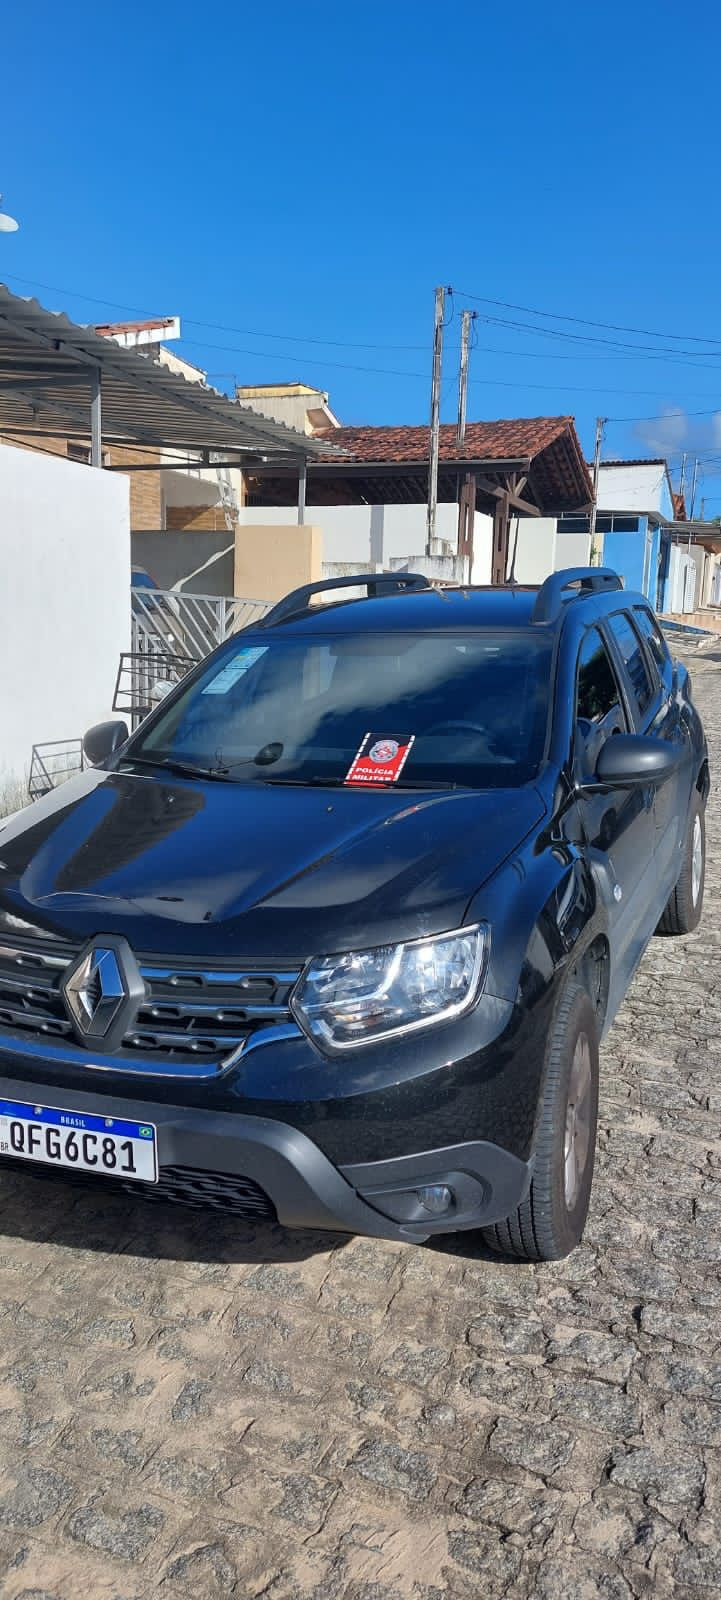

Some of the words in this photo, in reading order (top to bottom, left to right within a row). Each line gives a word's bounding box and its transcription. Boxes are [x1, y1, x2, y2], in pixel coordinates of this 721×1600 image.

[355, 767, 393, 775] POLÍCIA
[60, 1116, 86, 1128] BRASIL
[10, 1121, 137, 1173] QFG6C81
